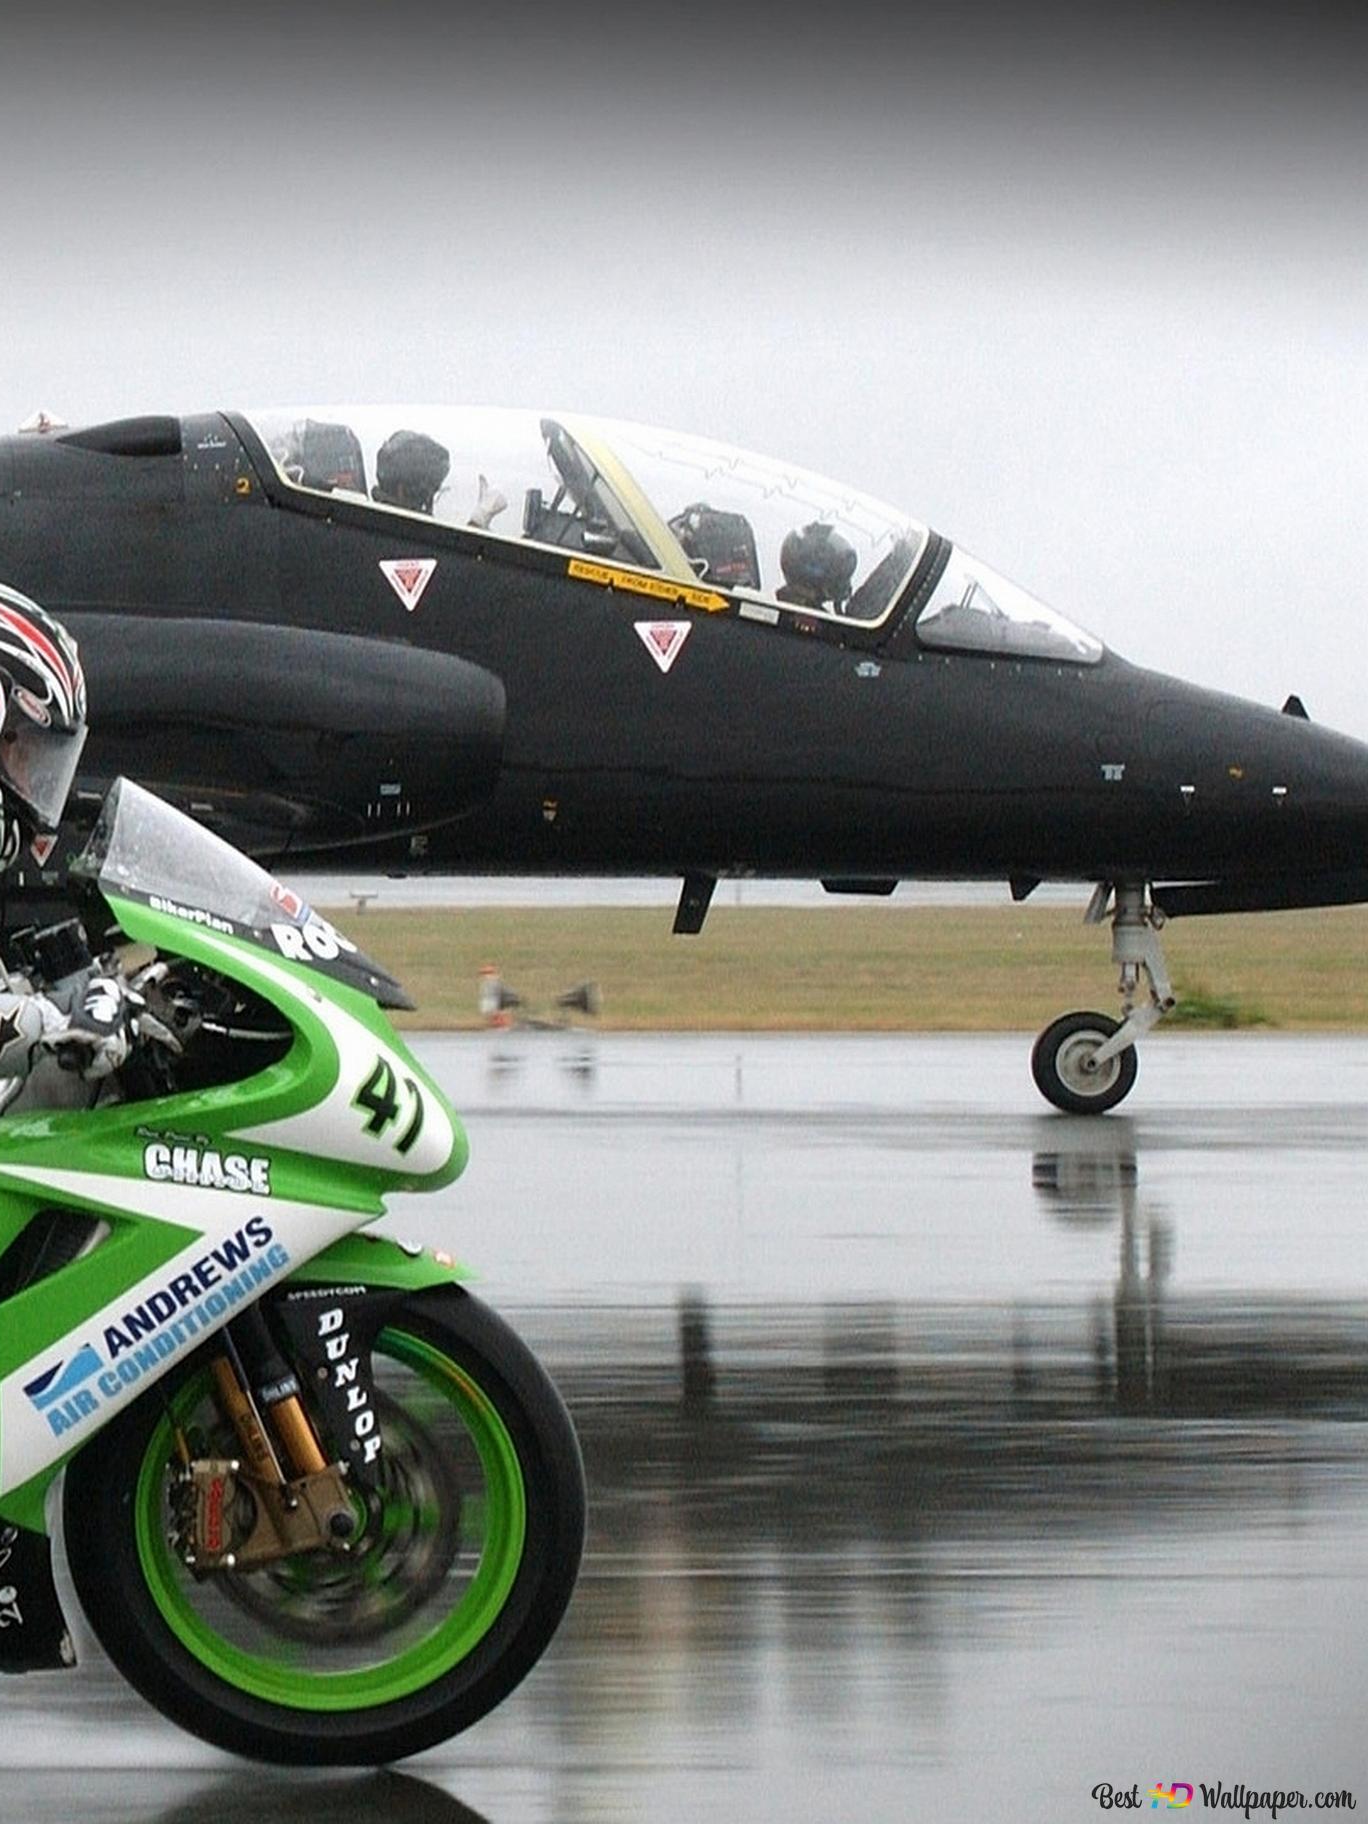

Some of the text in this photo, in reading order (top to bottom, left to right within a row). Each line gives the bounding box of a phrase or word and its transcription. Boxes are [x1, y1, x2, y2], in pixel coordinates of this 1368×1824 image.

[144, 1143, 271, 1195] CHASE
[352, 1053, 425, 1157] 41
[46, 1243, 290, 1437] AIR CONDITIONING
[102, 1216, 273, 1359] ANDREWS
[318, 1308, 381, 1464] DUNLOP
